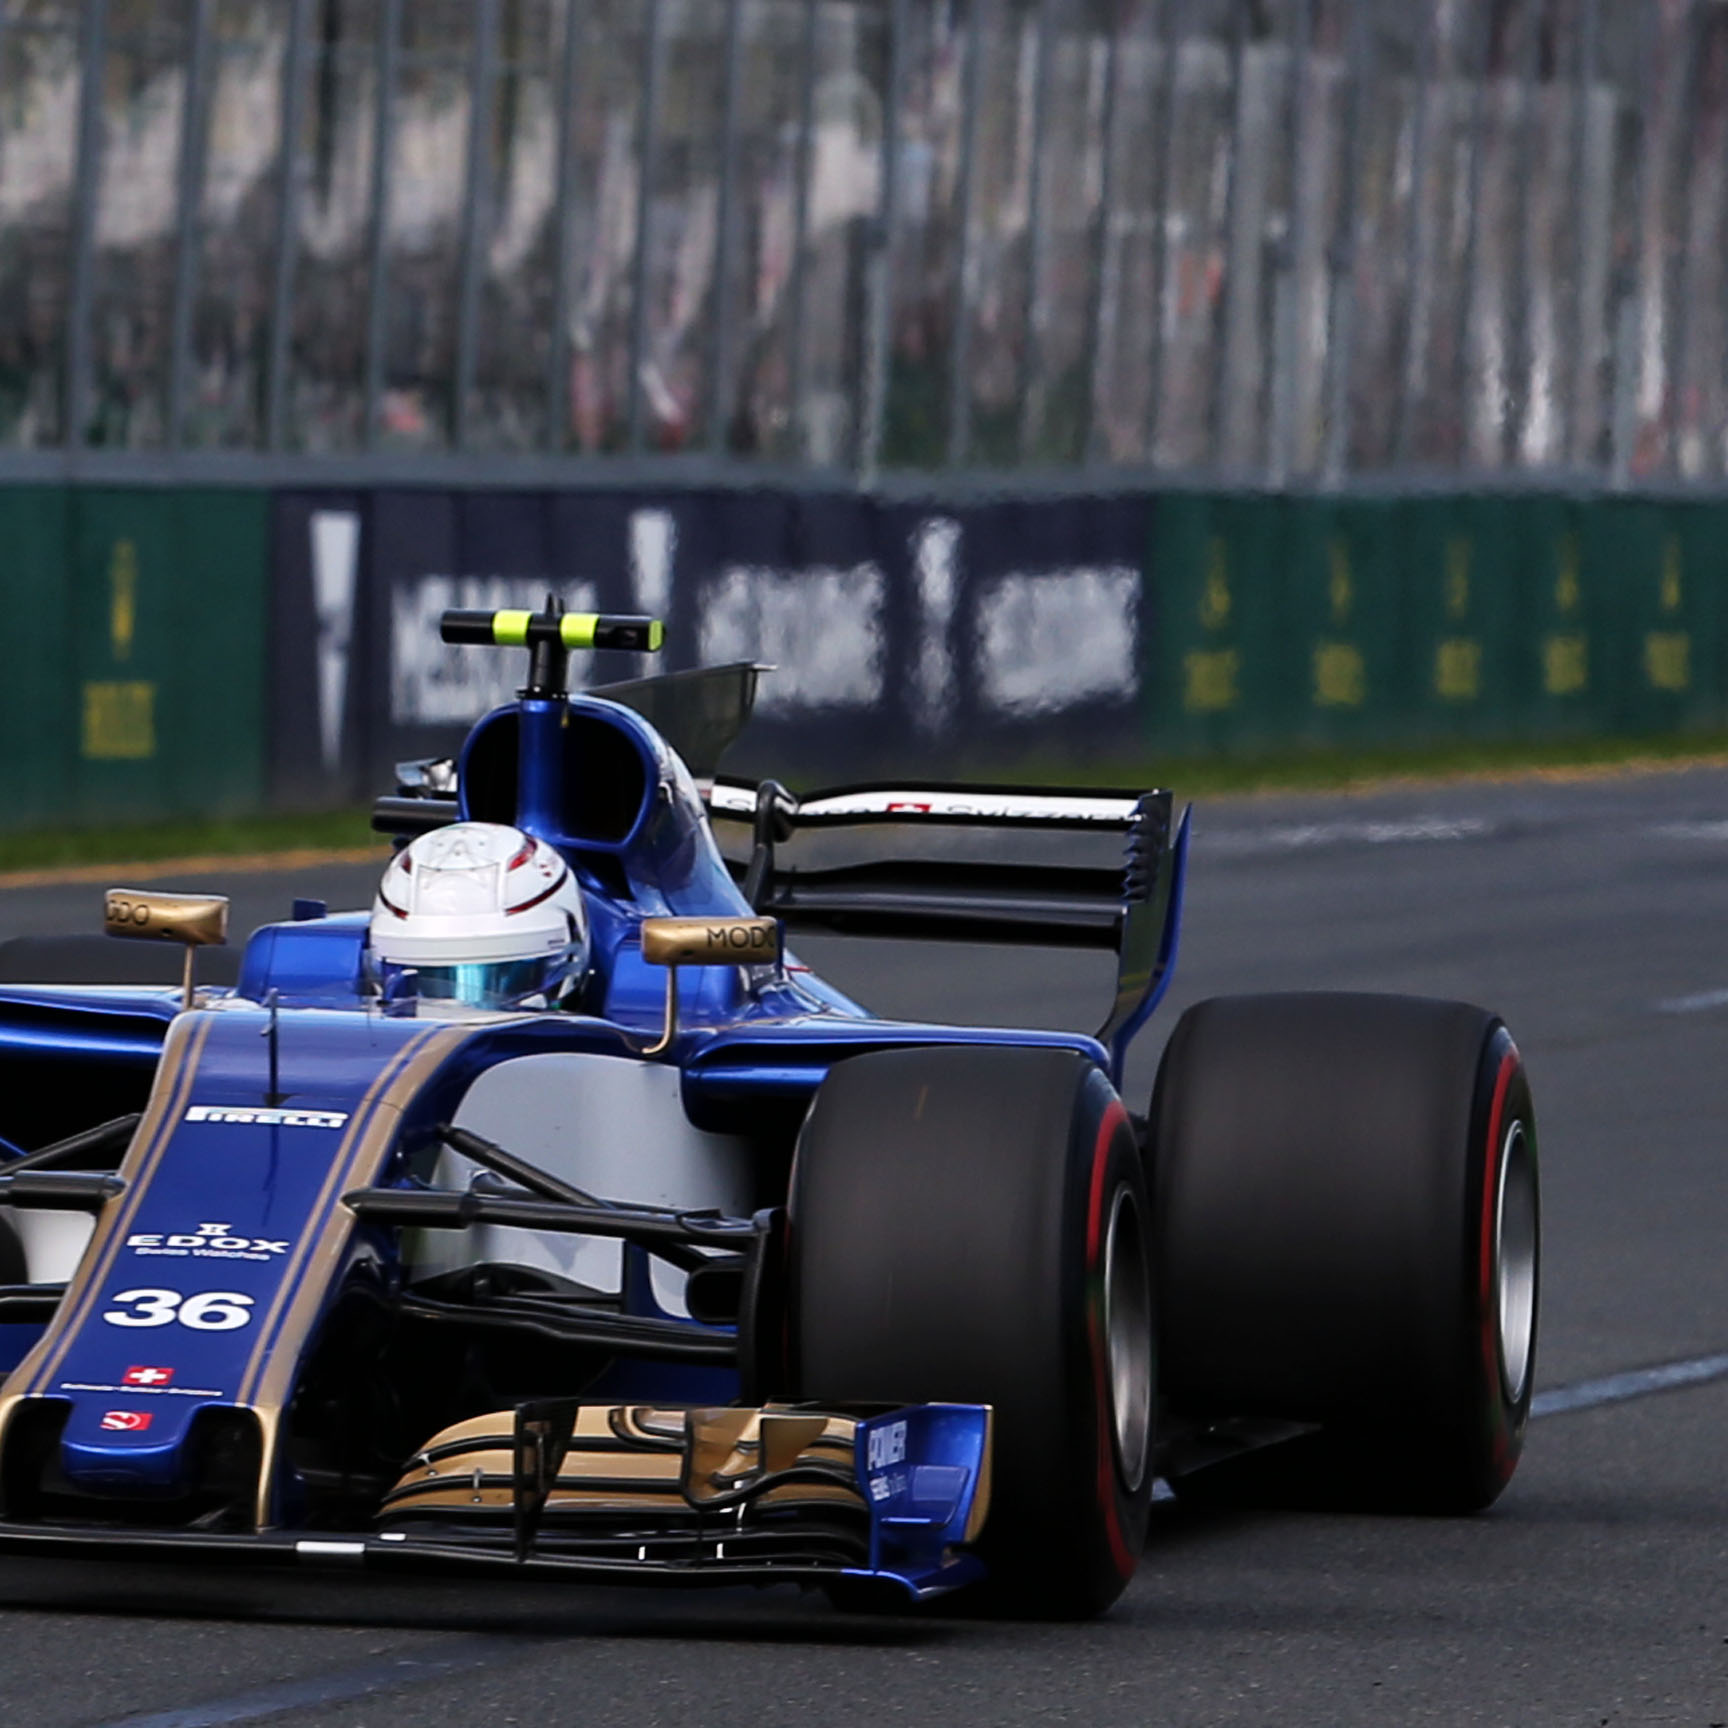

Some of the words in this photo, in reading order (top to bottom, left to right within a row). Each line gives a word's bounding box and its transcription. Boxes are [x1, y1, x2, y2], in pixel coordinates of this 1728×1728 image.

[184, 1105, 349, 1129] PIRELLI
[126, 1233, 291, 1255] EDOX
[103, 1288, 255, 1331] 36
